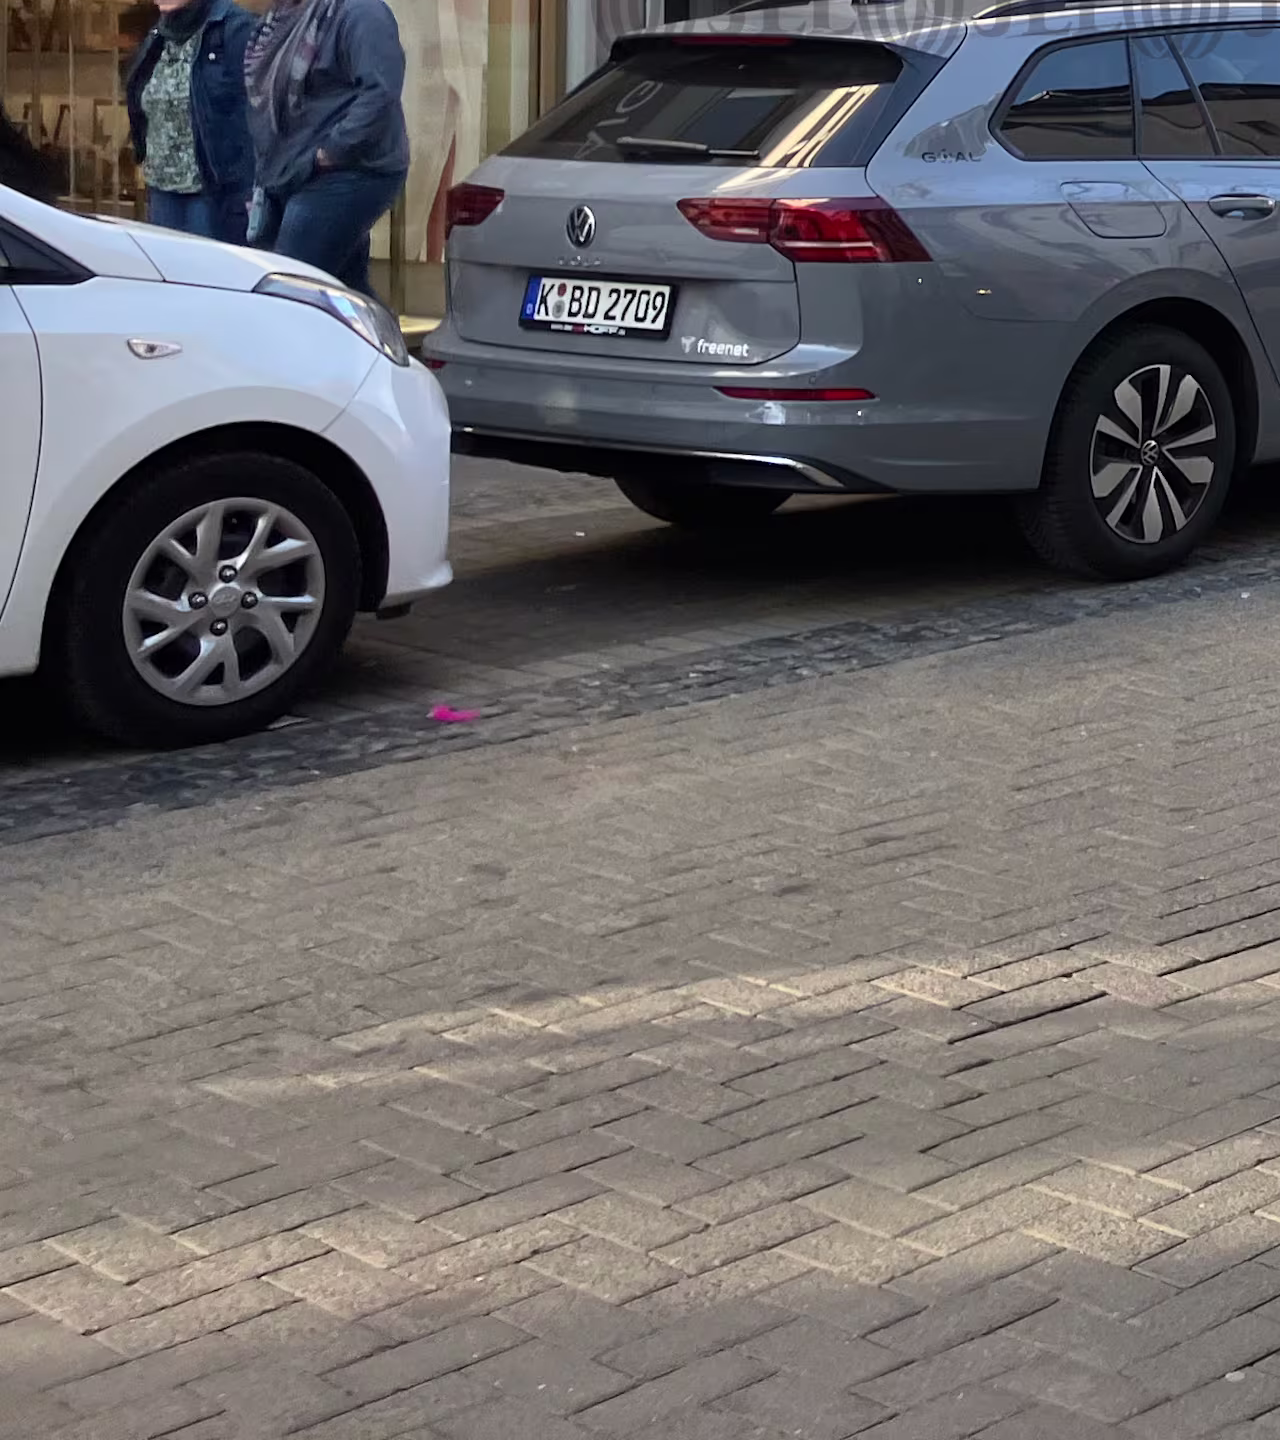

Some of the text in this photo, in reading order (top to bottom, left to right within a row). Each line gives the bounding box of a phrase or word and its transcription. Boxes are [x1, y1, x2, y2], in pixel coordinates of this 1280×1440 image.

[537, 283, 667, 324] K BD 2709
[696, 337, 750, 358] freenet
